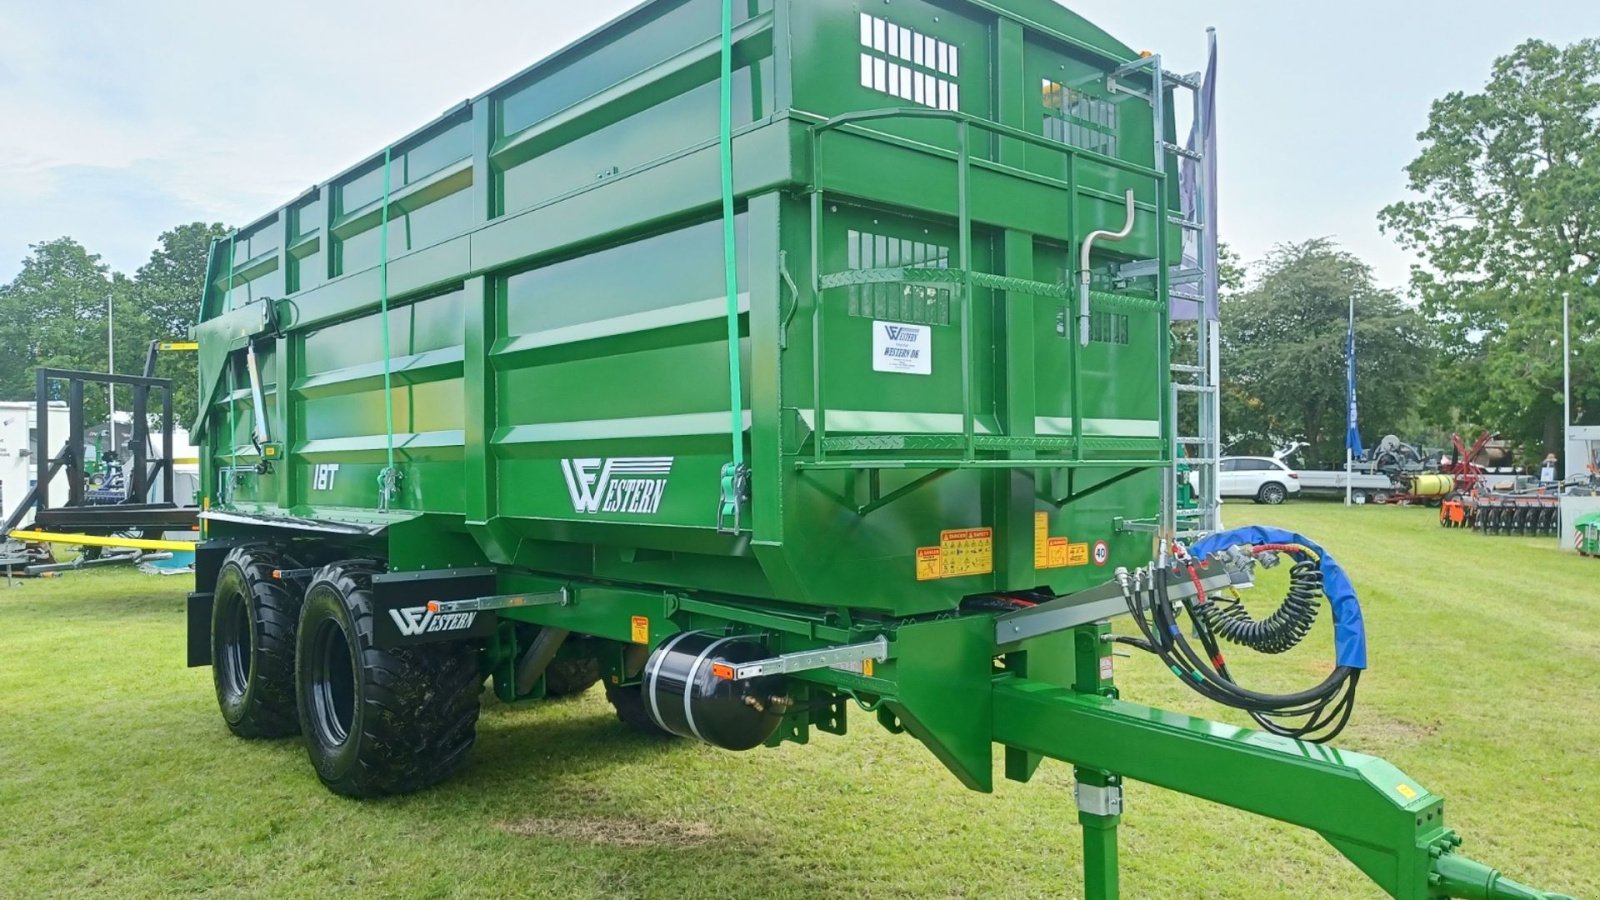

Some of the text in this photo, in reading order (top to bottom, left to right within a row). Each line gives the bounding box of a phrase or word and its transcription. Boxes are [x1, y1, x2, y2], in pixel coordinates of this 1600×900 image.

[885, 325, 919, 342] WESTERN
[313, 463, 340, 490] 18T
[560, 456, 673, 513] WESTERN
[1096, 548, 1105, 558] 40
[389, 606, 477, 636] WESTERN
